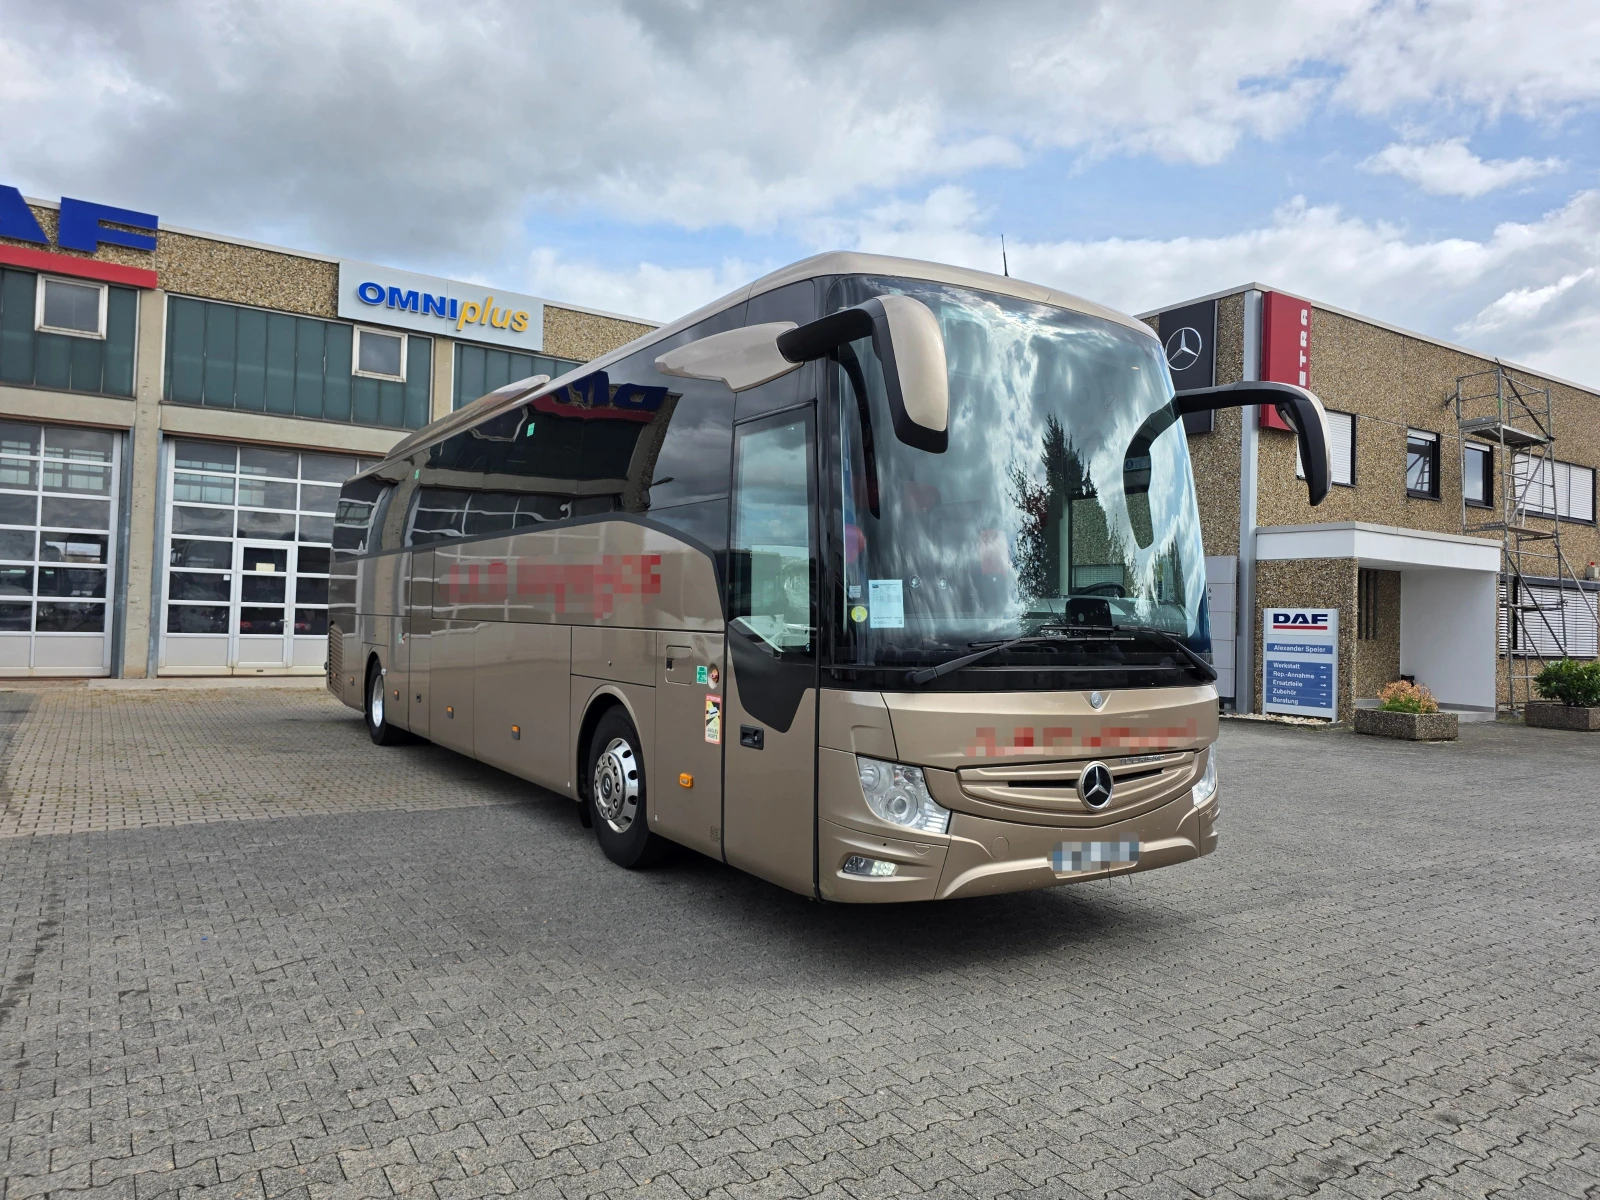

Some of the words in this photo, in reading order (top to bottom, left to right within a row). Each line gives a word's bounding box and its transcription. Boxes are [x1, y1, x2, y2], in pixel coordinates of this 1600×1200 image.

[357, 281, 530, 332] OMNIplus
[1299, 309, 1308, 387] ETRA
[1273, 613, 1328, 624] DAF
[1273, 671, 1315, 679] Rep.-Annahme
[1273, 680, 1303, 688] Ersatzteile
[1273, 688, 1297, 696] Zubehör
[1273, 697, 1299, 705] Beratung
